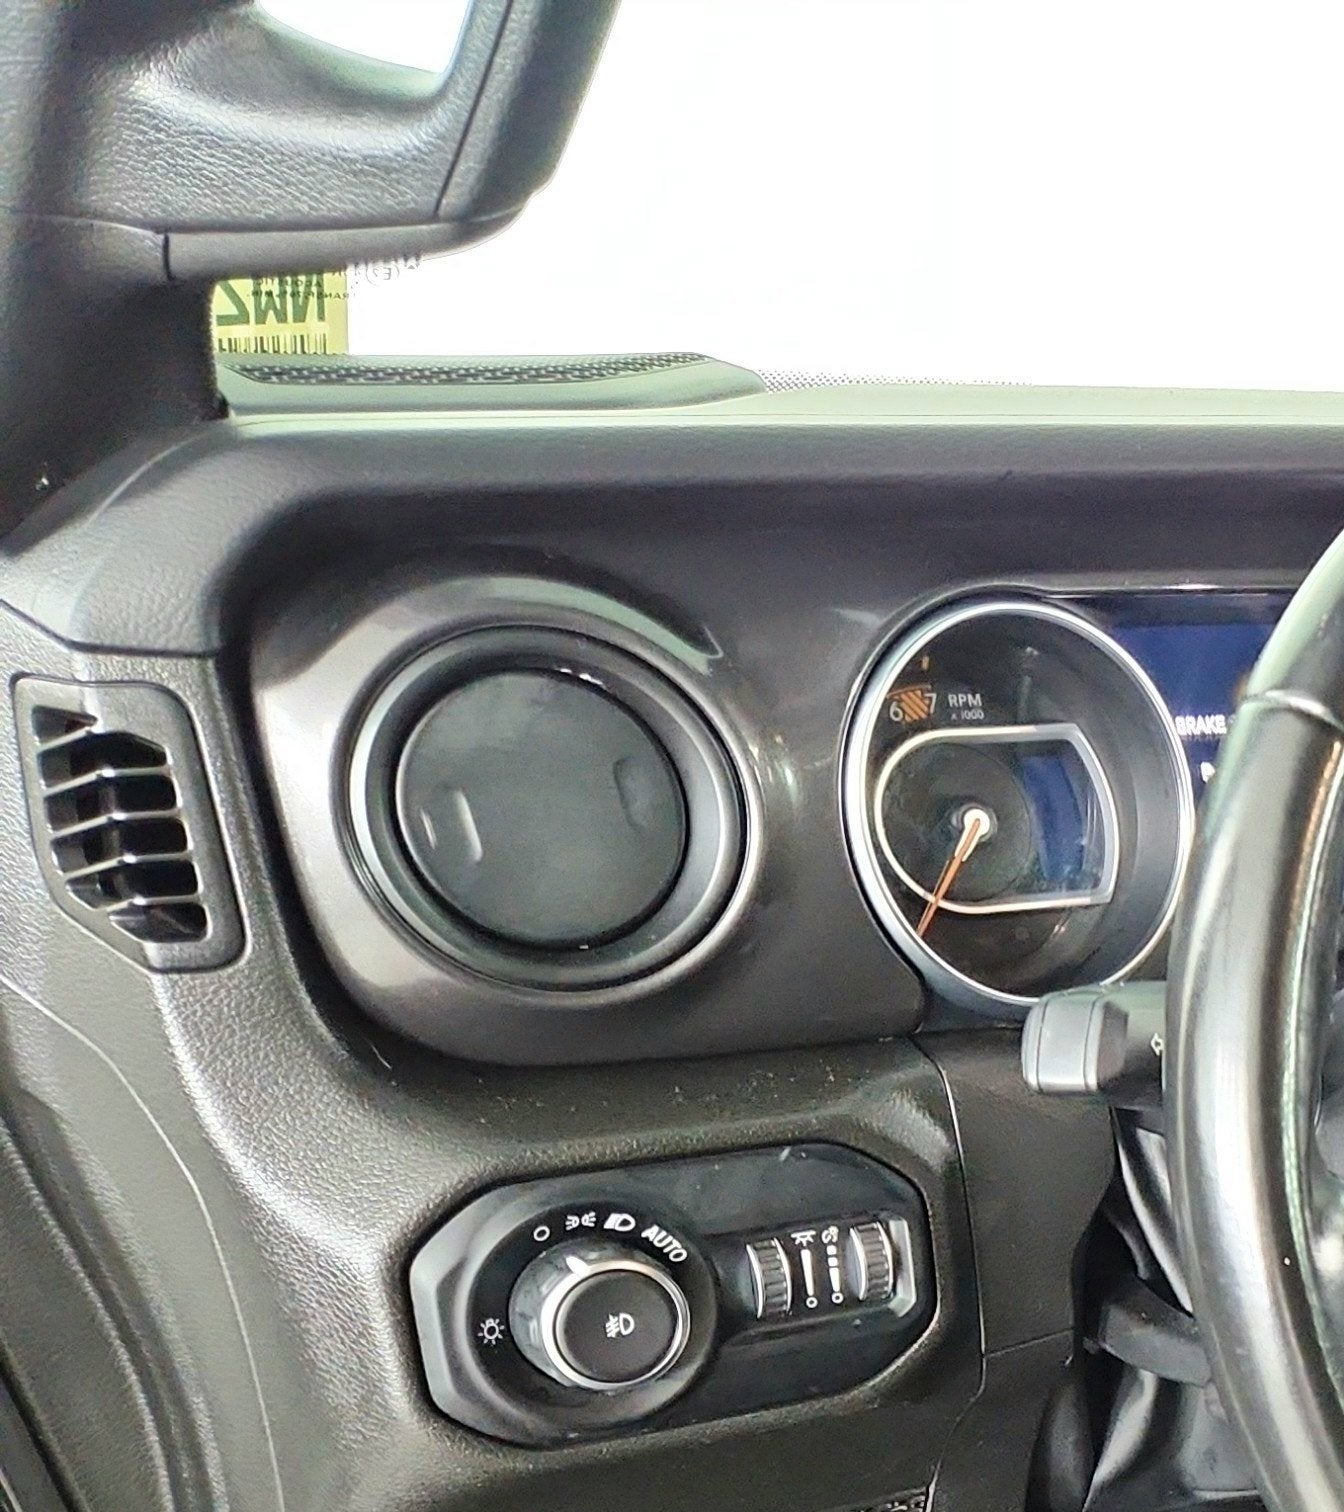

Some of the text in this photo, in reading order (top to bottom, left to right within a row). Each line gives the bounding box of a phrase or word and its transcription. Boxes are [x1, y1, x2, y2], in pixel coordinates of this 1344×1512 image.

[947, 693, 982, 708] RPM
[889, 701, 904, 722] 6
[1174, 714, 1227, 736] BRAKE
[641, 1224, 688, 1263] AUTO
